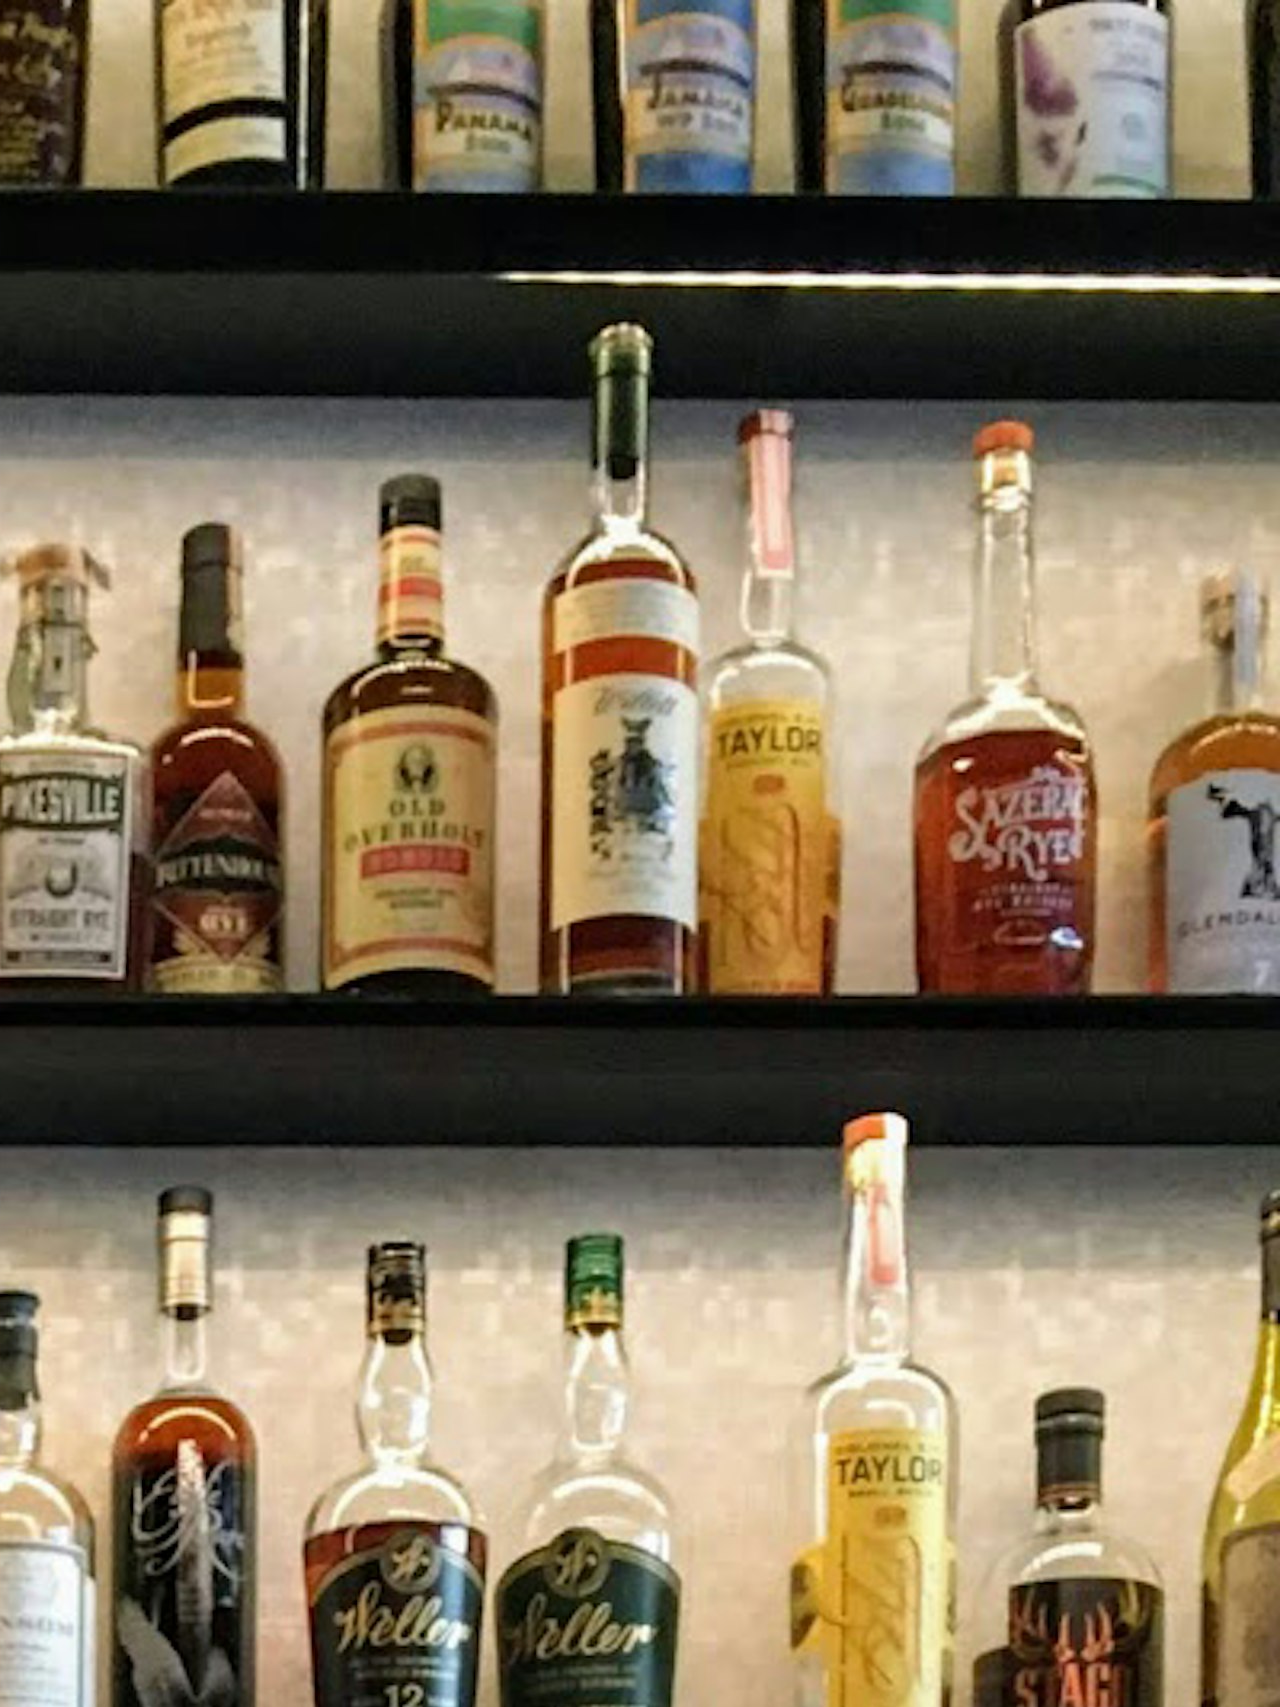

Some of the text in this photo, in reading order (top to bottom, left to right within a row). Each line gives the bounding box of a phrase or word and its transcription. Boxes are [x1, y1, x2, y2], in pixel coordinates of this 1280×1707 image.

[717, 725, 821, 760] TAYLOR
[1, 779, 121, 824] PIKESVILLE
[389, 799, 446, 817] OLD
[343, 820, 486, 855] OVERHOLT
[836, 1455, 942, 1486] TAYLOR
[333, 1580, 471, 1653] Weller
[506, 1592, 657, 1666] Weller
